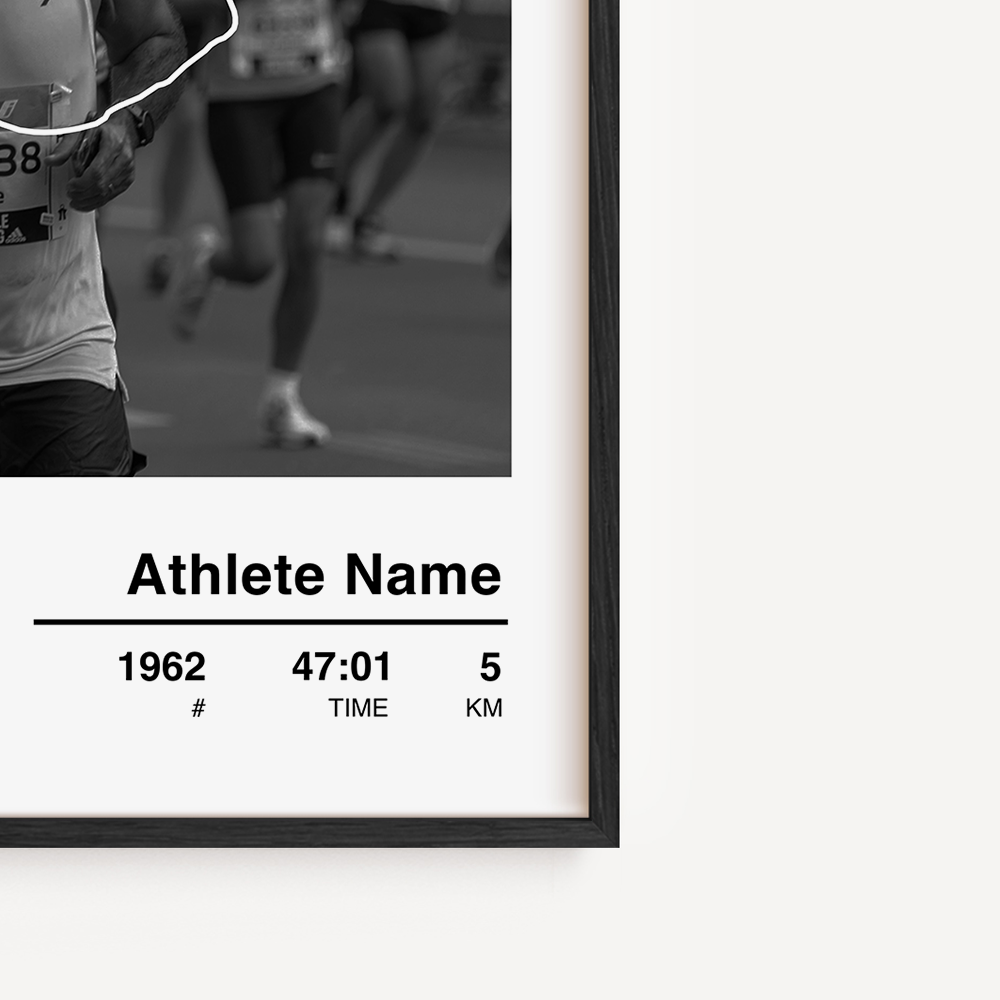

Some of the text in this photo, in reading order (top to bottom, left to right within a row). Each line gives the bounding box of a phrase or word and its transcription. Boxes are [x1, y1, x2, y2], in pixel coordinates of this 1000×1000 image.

[127, 553, 500, 595] Athlete Name
[119, 651, 501, 681] 1962 47:01 5
[192, 698, 502, 718] # TIME KM
